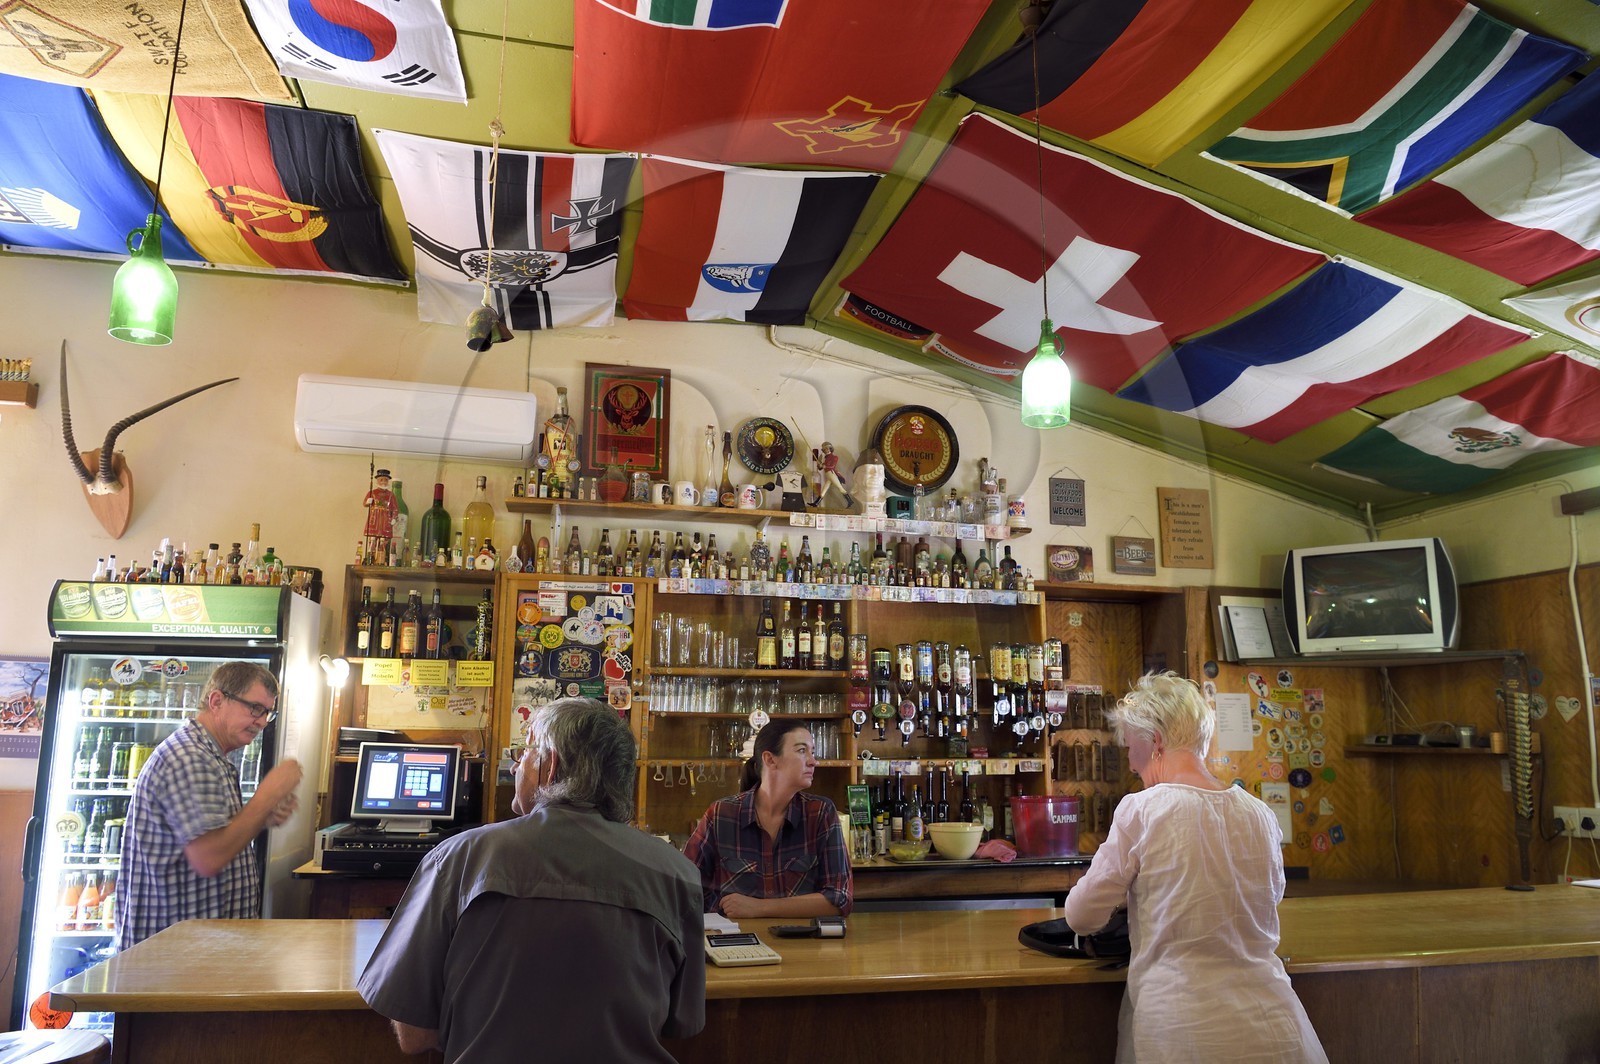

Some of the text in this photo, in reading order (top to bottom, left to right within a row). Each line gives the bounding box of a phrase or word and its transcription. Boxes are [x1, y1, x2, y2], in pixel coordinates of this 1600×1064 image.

[125, 2, 188, 75] FOUNDATION
[864, 304, 913, 332] FOOTBALL
[900, 450, 934, 460] DRAUGHT
[1053, 507, 1084, 516] WELCOME
[1124, 546, 1147, 560] BEER
[152, 623, 260, 634] EXCEPTIONAL QUALITY
[1052, 814, 1077, 824] CAMPARI
